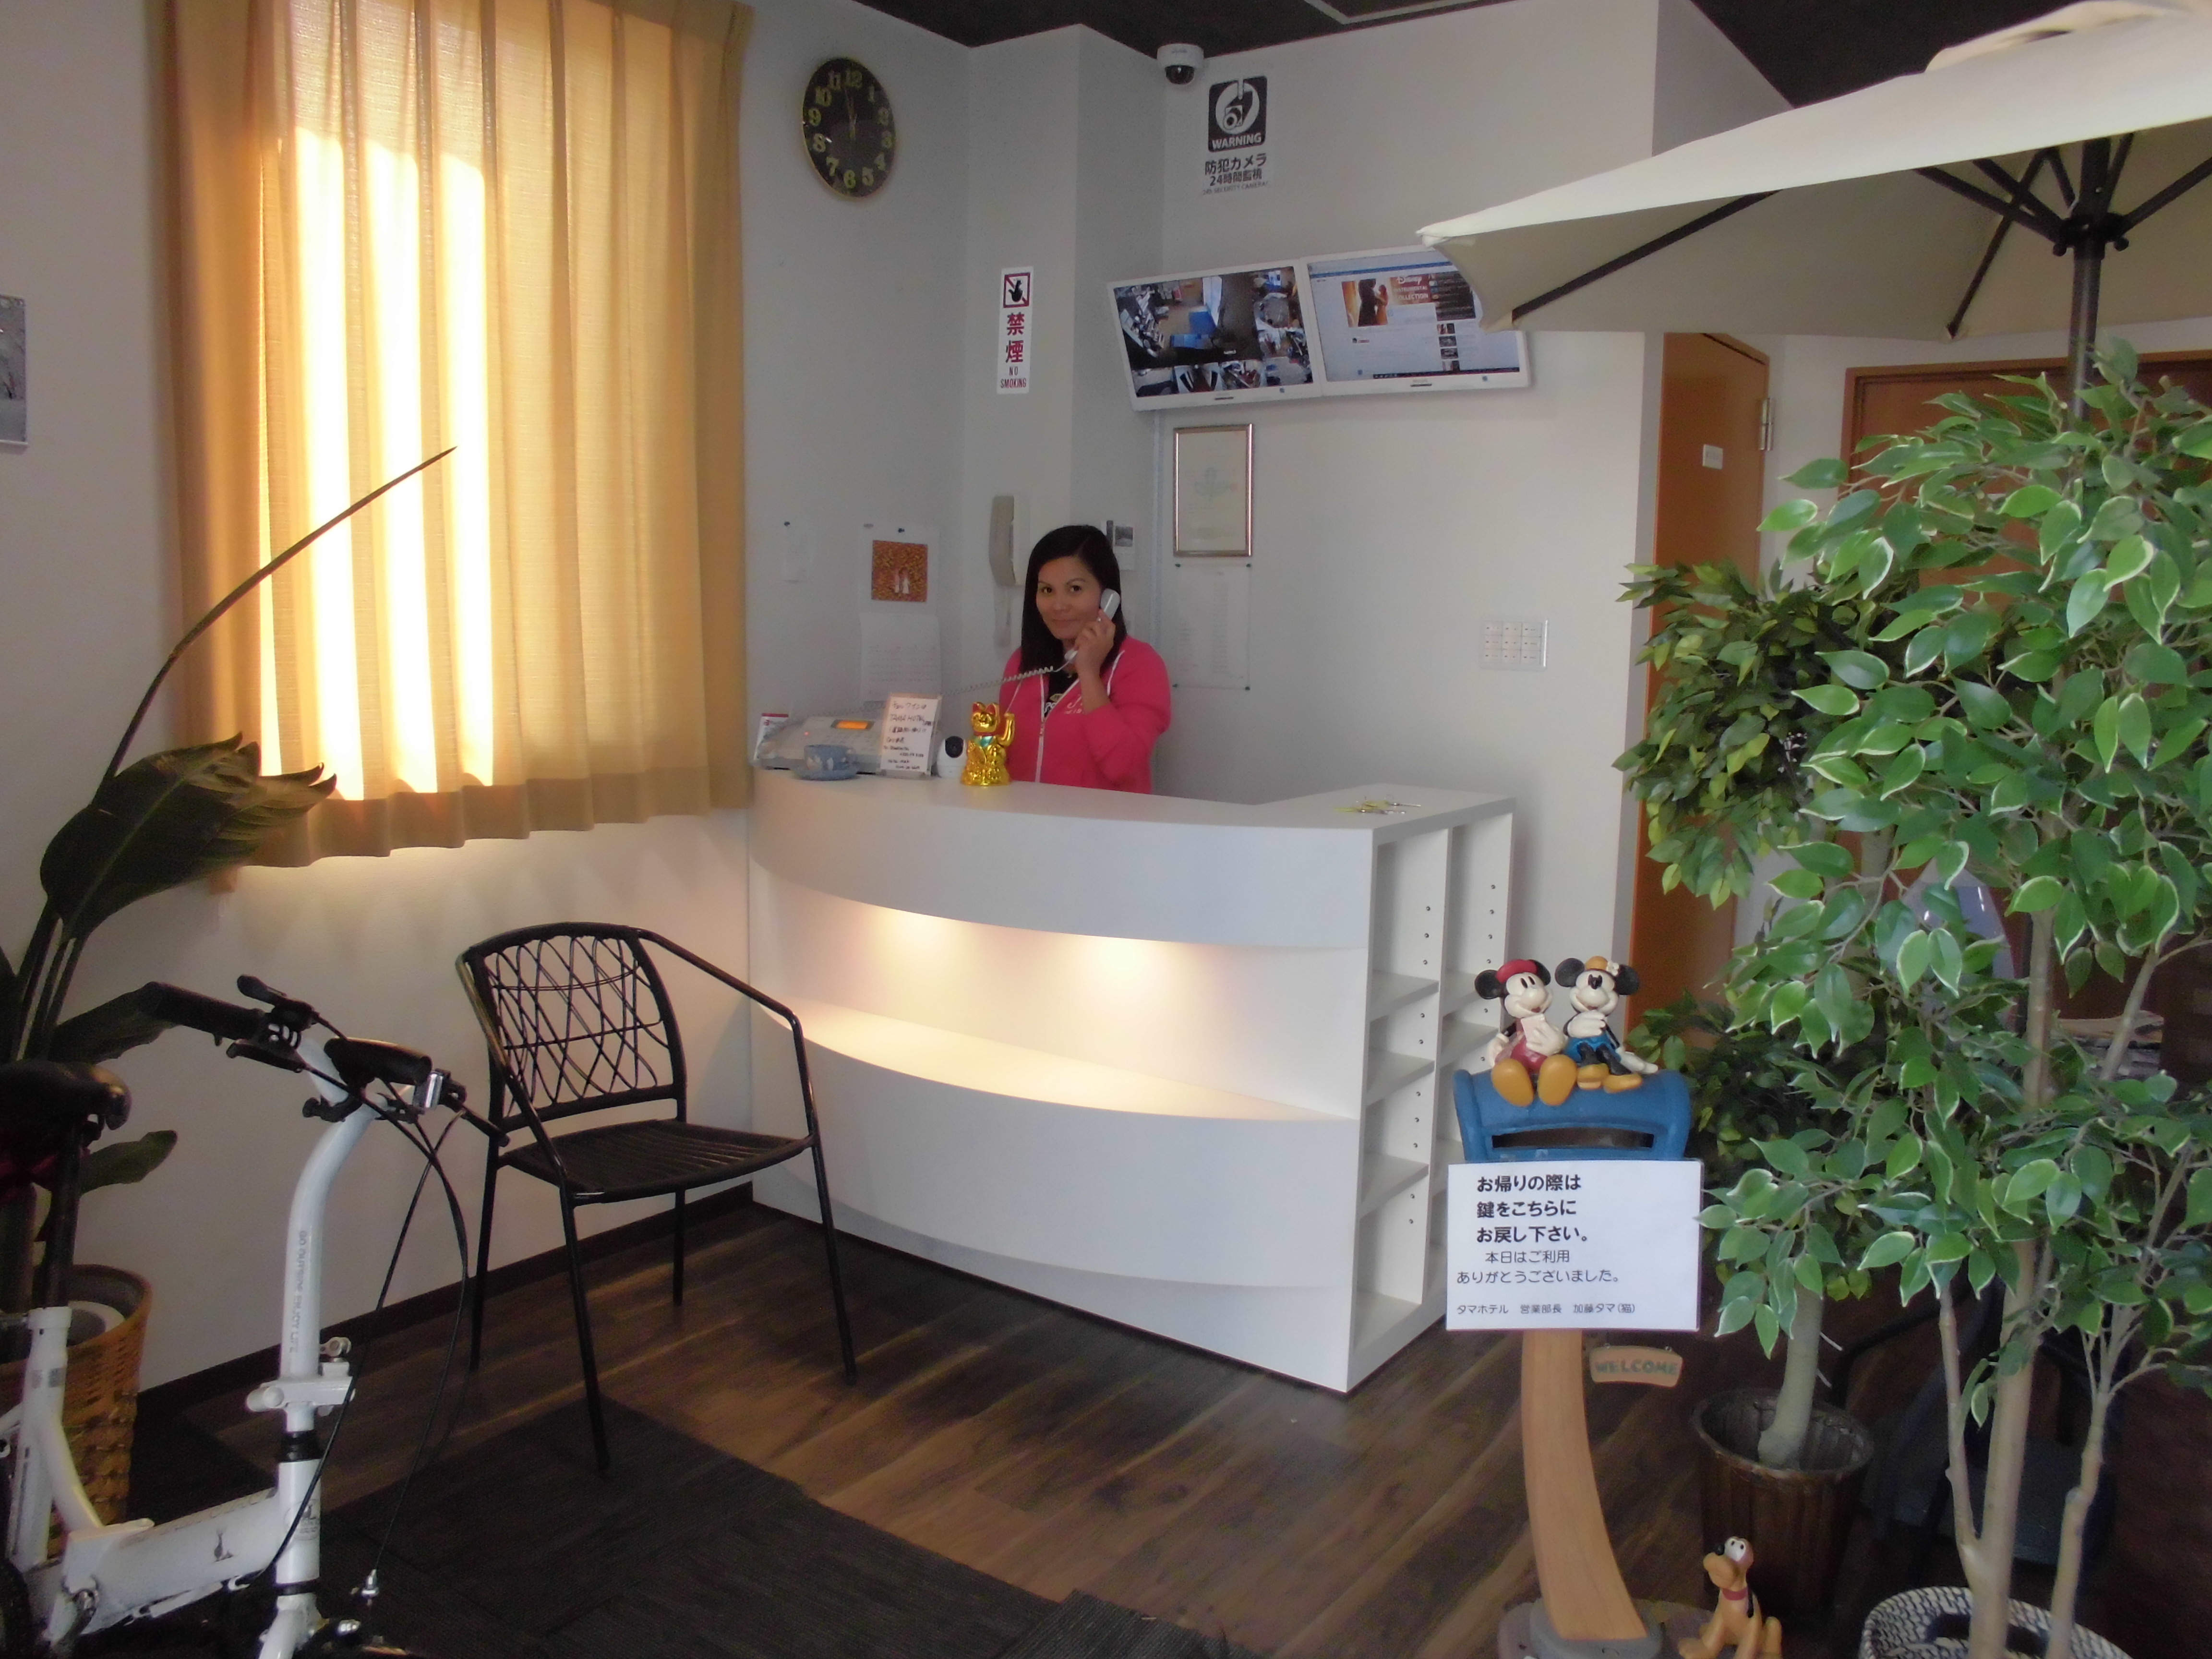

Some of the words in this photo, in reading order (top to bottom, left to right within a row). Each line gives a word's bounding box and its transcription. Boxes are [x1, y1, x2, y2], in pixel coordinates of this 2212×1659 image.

[816, 86, 832, 107] 10
[808, 107, 821, 127] 9
[813, 133, 826, 153] 8
[1211, 132, 1262, 150] WARNING
[826, 156, 839, 176] 7
[874, 152, 886, 171] 4
[1205, 153, 1267, 176] 防犯カメラ
[862, 167, 874, 187] 5
[1210, 168, 1262, 186] 24時間監視
[1396, 276, 1422, 285] Disney
[1005, 312, 1025, 363] 禁煙
[1009, 366, 1018, 376] NO
[1000, 378, 1027, 388] SMOKING
[1477, 1174, 1581, 1192] お帰りの際は
[1477, 1200, 1577, 1218] 鍵をこちらに
[299, 1230, 308, 1246] GO
[1477, 1226, 1588, 1243] お戻し下さい。
[1485, 1250, 1570, 1264] 本日はご利用
[296, 1248, 306, 1291] OUTSIDE
[1457, 1270, 1619, 1285] ありがとうございました。
[292, 1295, 302, 1329] ENJOY
[1457, 1304, 1509, 1314] タマホテル
[1520, 1304, 1563, 1314] 営業部長
[289, 1331, 300, 1354] LIFE
[1596, 1359, 1678, 1376] WELCOME
